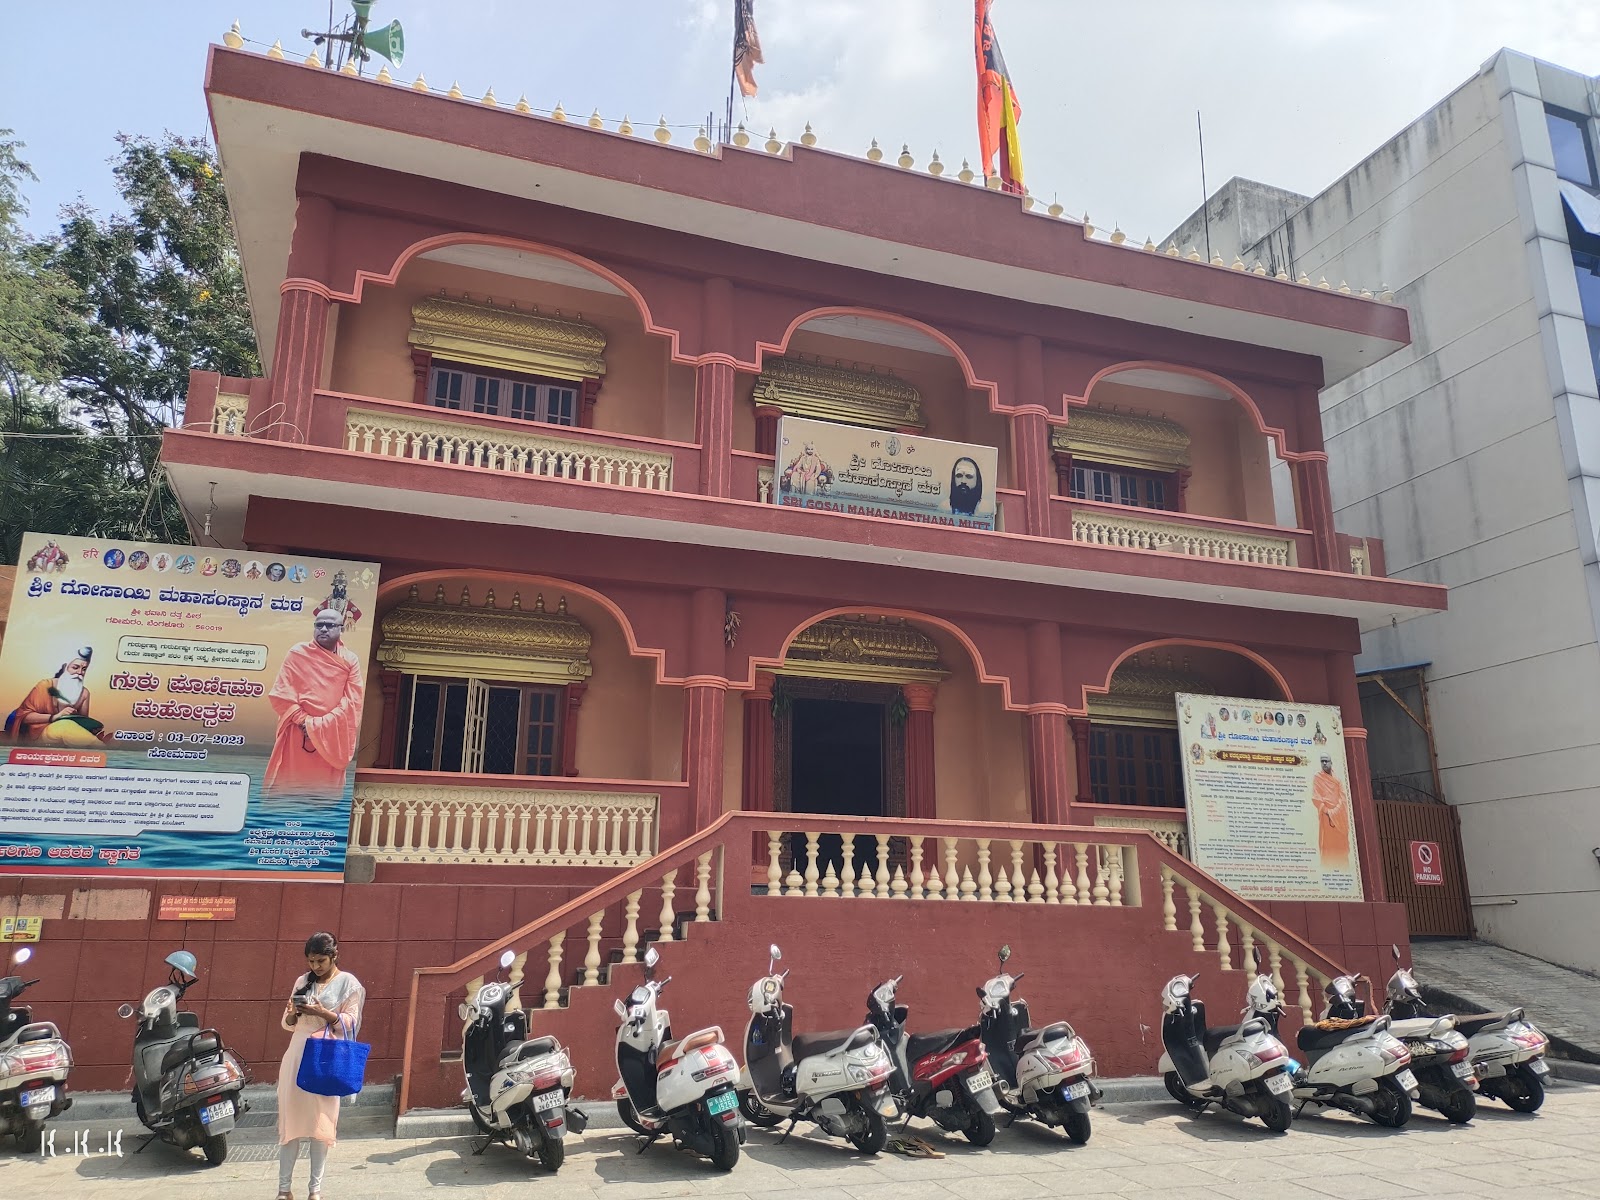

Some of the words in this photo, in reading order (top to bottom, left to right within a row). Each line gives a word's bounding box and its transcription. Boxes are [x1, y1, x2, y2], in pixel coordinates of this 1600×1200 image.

[850, 454, 866, 472] ಶ್ರೀ
[871, 457, 933, 478] ಗೋಸಾಯಿ
[838, 469, 914, 497] ಮಹಾಸಂಸ್ಥಾನ
[917, 480, 942, 495] ಮಠ
[782, 496, 803, 508] SRI
[806, 499, 844, 514] GOSAI
[848, 504, 955, 526] MAHASAMSTHANA
[82, 549, 100, 559] हरि
[28, 576, 53, 598] ಶ್ರೀ
[60, 579, 151, 600] ಗೋಸಾಯಿ
[158, 586, 264, 618] ಮಹಾಸಂಸ್ಥಾನ
[270, 595, 304, 613] ಮಠ
[130, 608, 141, 616] ಶ್ರೀ
[111, 671, 160, 690] ಗುರು
[132, 699, 236, 728] ಮಹೋತ್ಸವ
[114, 730, 154, 742] ದಿನಾಂಕ
[167, 732, 244, 746] 03-07-2023
[16, 752, 76, 764] ಕಾರ್ಯಕ್ರಮಗಳ
[148, 748, 208, 760] ಸೋಮವಾರ
[48, 844, 94, 858] ಆದರದ
[98, 846, 141, 864] ಸ್ವಾಗತ
[1423, 866, 1432, 874] NO
